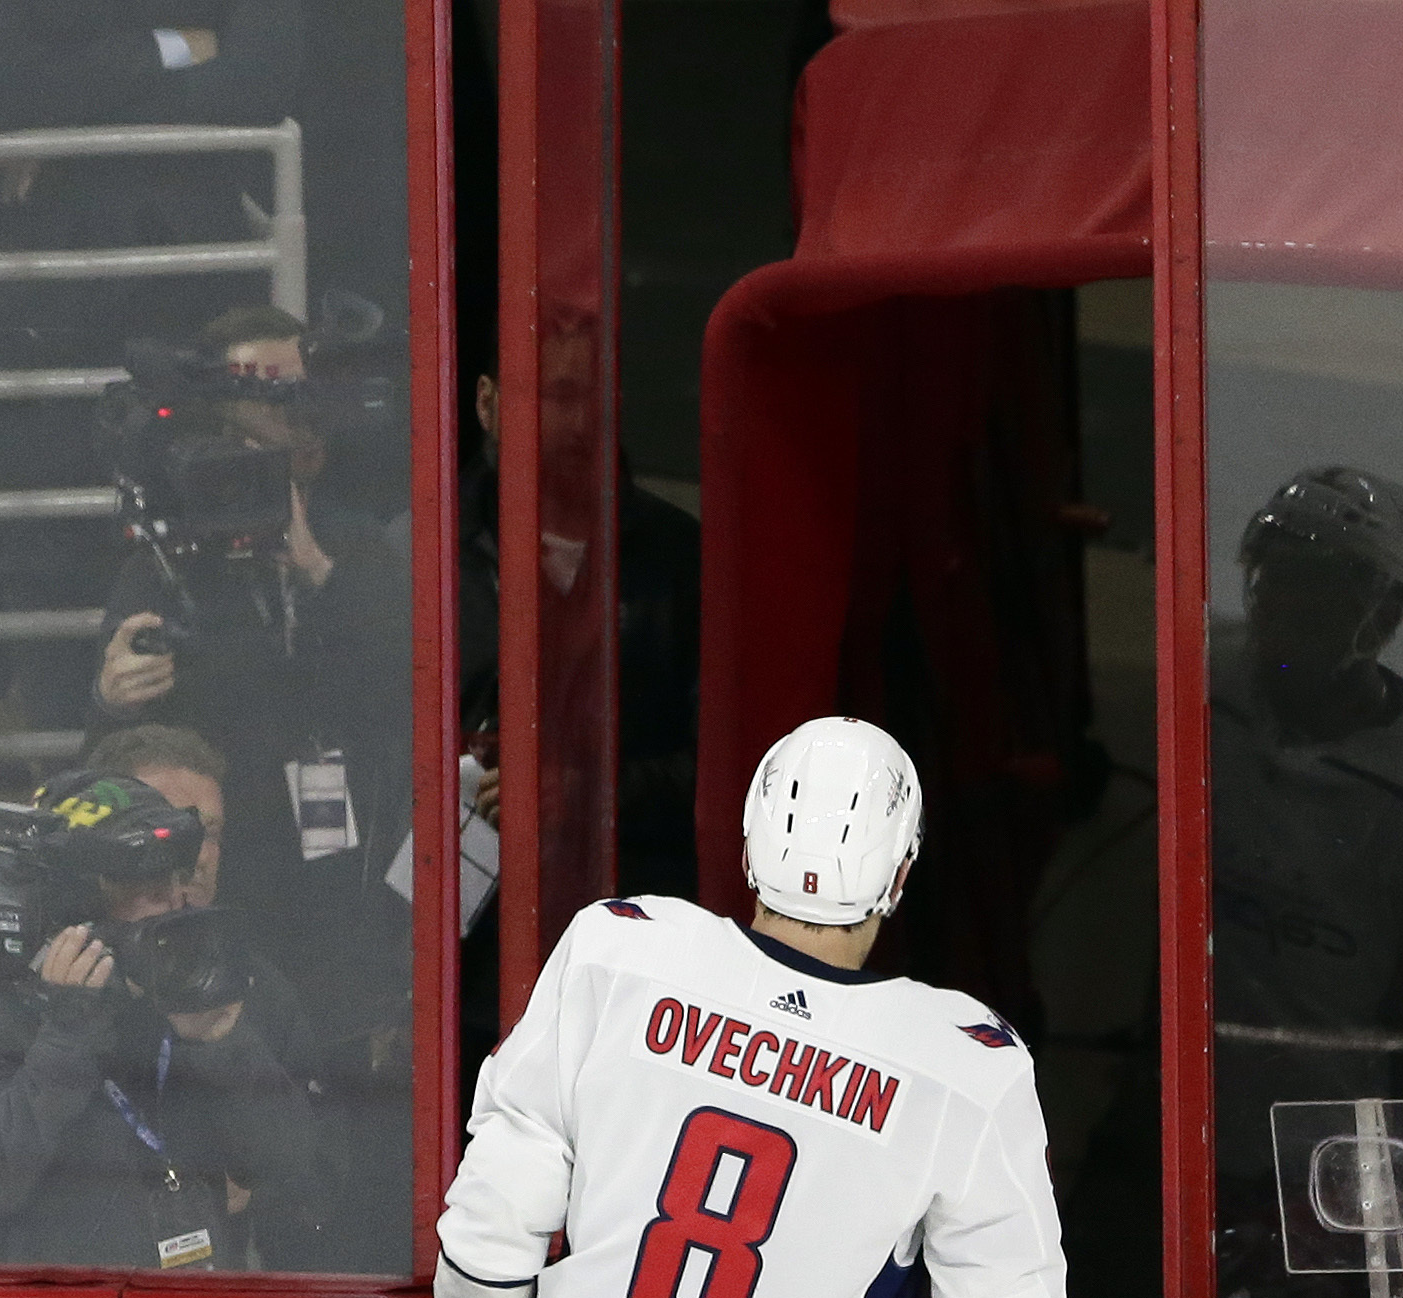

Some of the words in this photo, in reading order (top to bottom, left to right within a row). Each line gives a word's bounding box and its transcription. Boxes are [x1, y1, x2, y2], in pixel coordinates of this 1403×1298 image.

[803, 872, 818, 894] 8
[769, 1000, 812, 1020] adidas
[645, 997, 900, 1134] OVECHKIN
